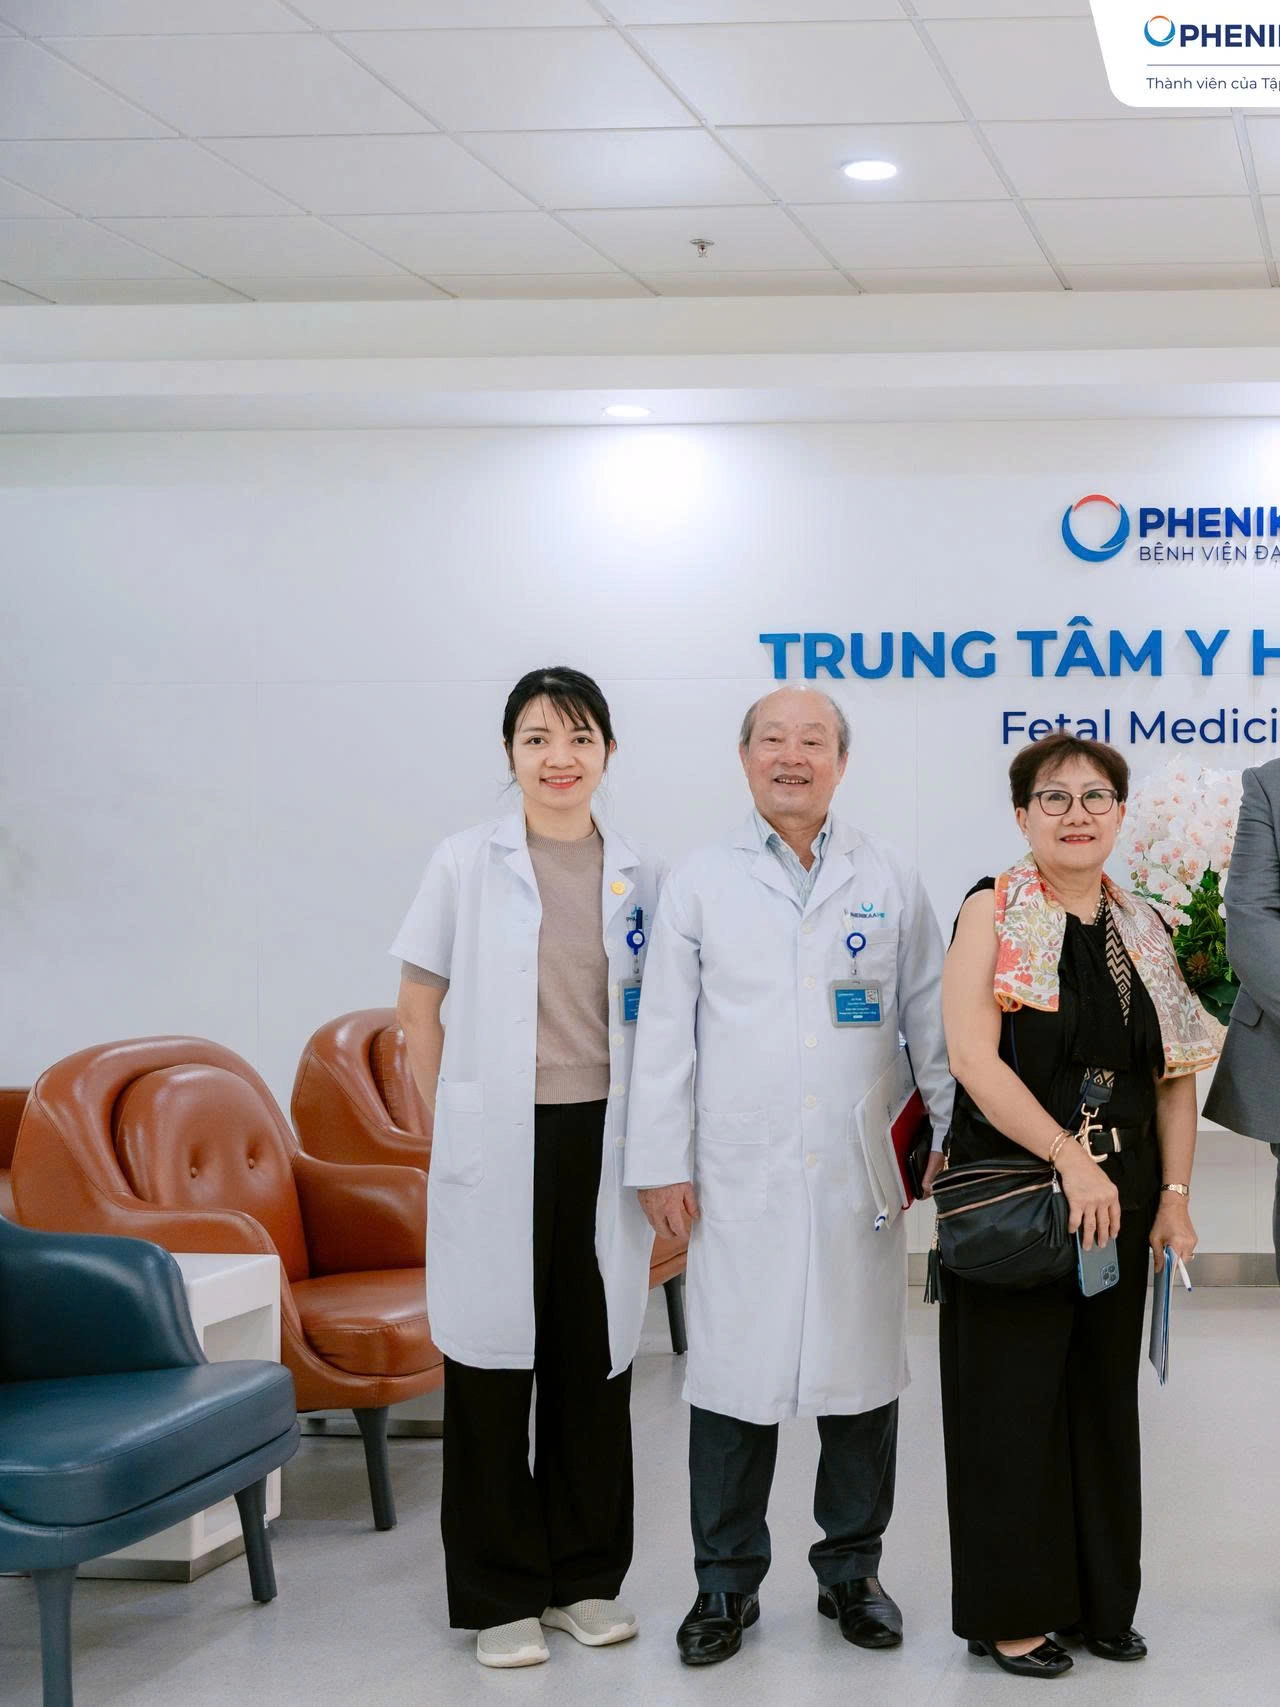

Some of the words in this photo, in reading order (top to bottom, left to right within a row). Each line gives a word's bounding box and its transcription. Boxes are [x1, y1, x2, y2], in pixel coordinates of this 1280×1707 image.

[1139, 541, 1195, 565] BỆNH
[1201, 540, 1248, 565] VIỆN
[759, 630, 997, 680] TRUNG
[1016, 615, 1163, 677] TÂM
[1184, 629, 1230, 676] Y
[1002, 708, 1111, 745] Fetal
